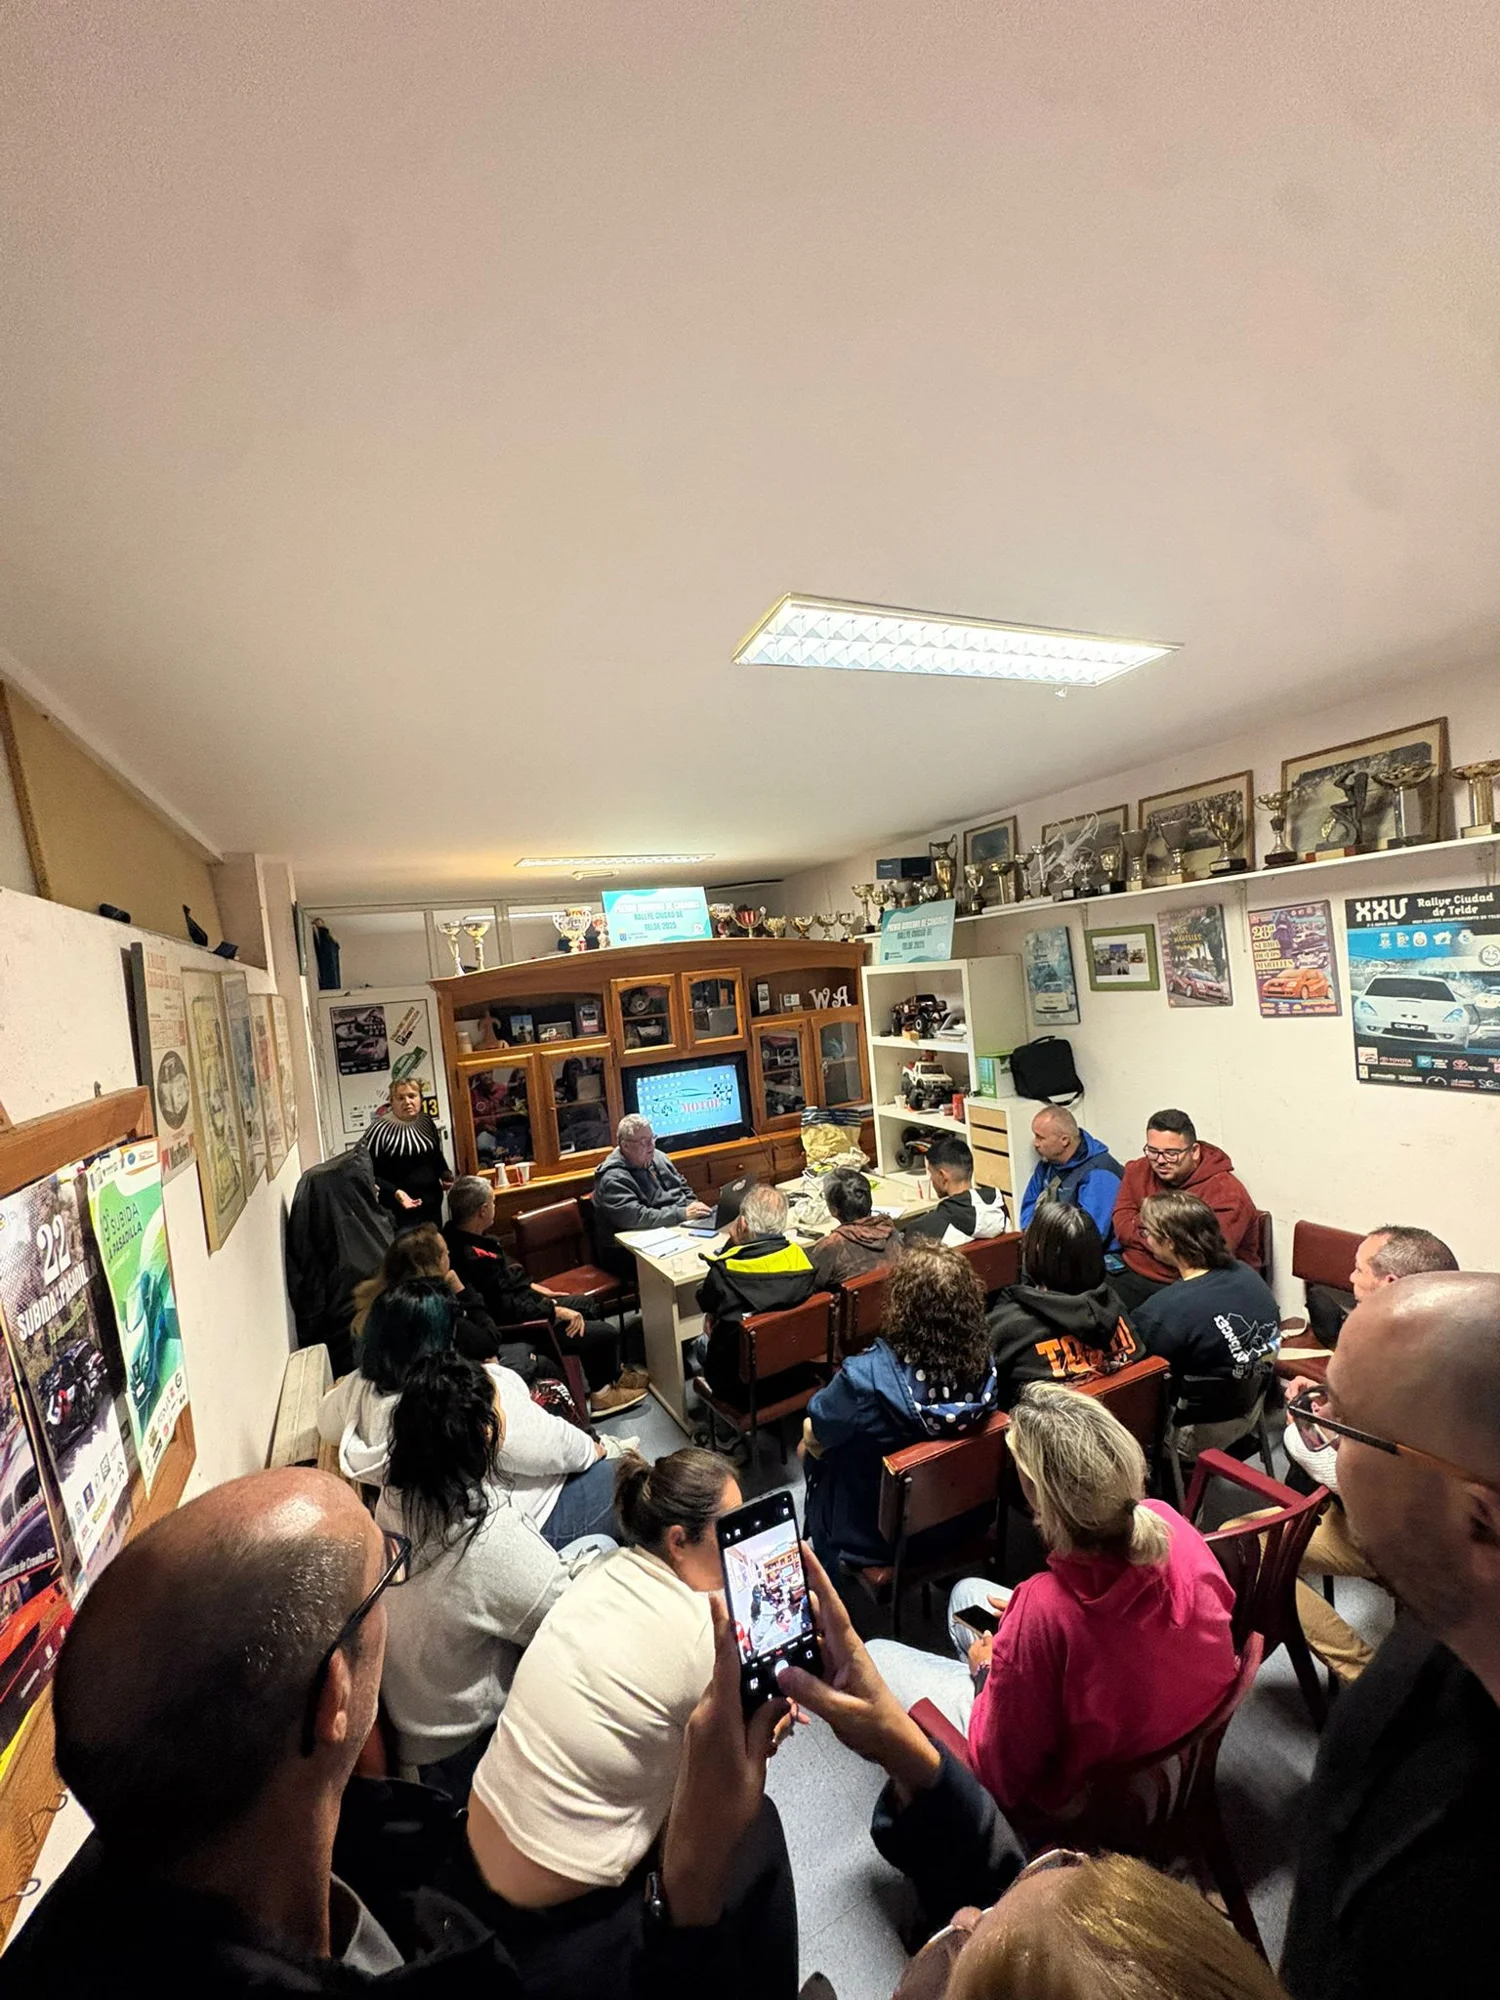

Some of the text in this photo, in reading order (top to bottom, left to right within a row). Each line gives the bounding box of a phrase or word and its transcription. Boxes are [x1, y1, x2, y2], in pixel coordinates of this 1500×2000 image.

[1355, 898, 1408, 922] XXV
[1417, 892, 1494, 908] Rallye Ciudad
[1432, 905, 1479, 916] de Telde
[809, 985, 851, 1010] W A
[111, 1202, 140, 1236] SUBIDA
[36, 1214, 72, 1287] 22
[17, 1294, 58, 1342] SUBIDA
